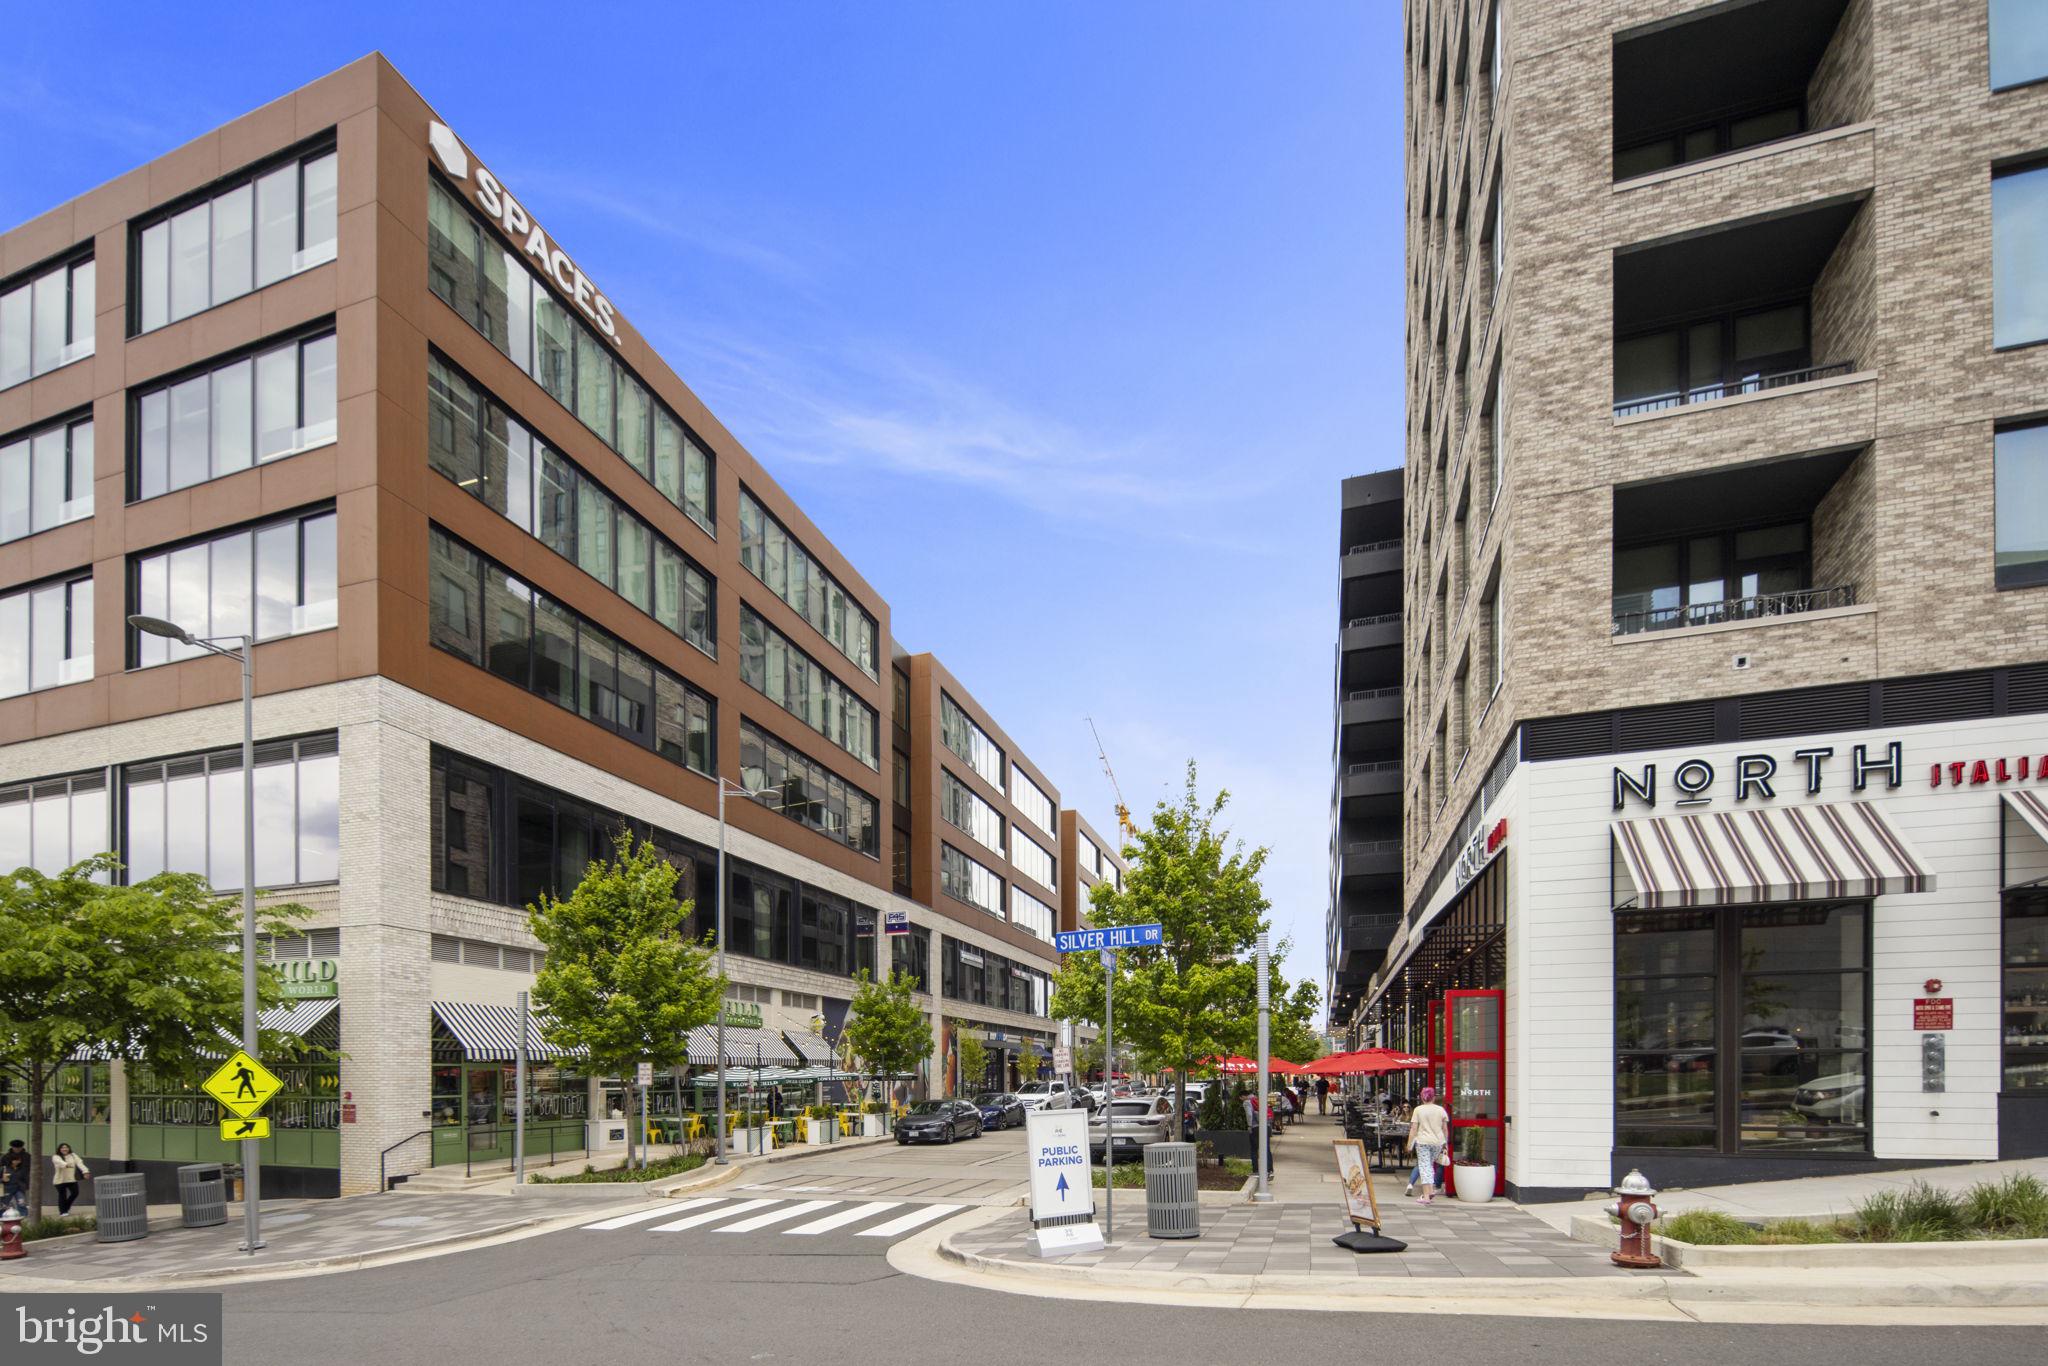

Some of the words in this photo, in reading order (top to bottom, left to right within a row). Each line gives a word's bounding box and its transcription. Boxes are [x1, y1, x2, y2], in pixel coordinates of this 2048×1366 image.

[1612, 740, 1903, 811] NORTH
[1930, 755, 2048, 788] ITALIA
[1060, 931, 1104, 950] SILVER
[1110, 928, 1139, 946] HILL
[1145, 929, 1158, 941] DR
[288, 985, 328, 994] WORLD
[1460, 1089, 1491, 1097] NORTH
[1042, 1145, 1078, 1157] PUBLIC
[1038, 1155, 1083, 1168] PARKING
